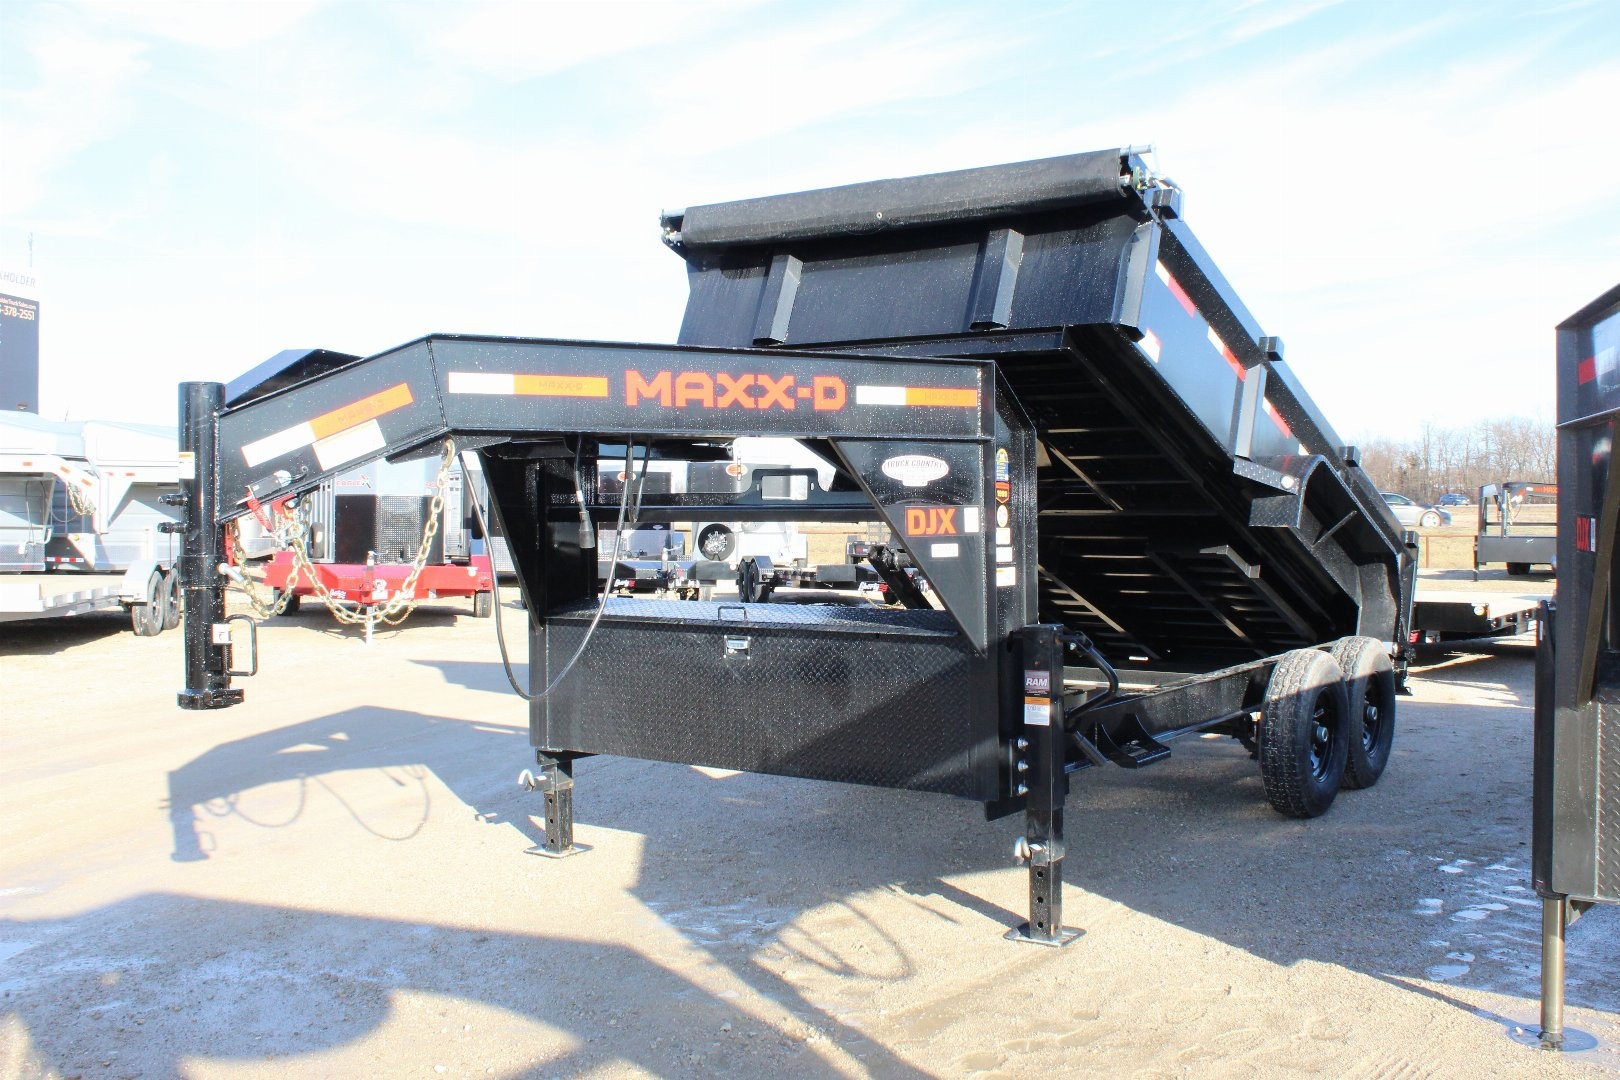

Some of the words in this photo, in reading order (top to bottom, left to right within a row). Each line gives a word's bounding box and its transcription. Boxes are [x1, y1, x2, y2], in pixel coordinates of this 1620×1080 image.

[625, 369, 847, 411] MAXX-D
[907, 508, 957, 535] DJX
[1026, 677, 1048, 687] RAM
